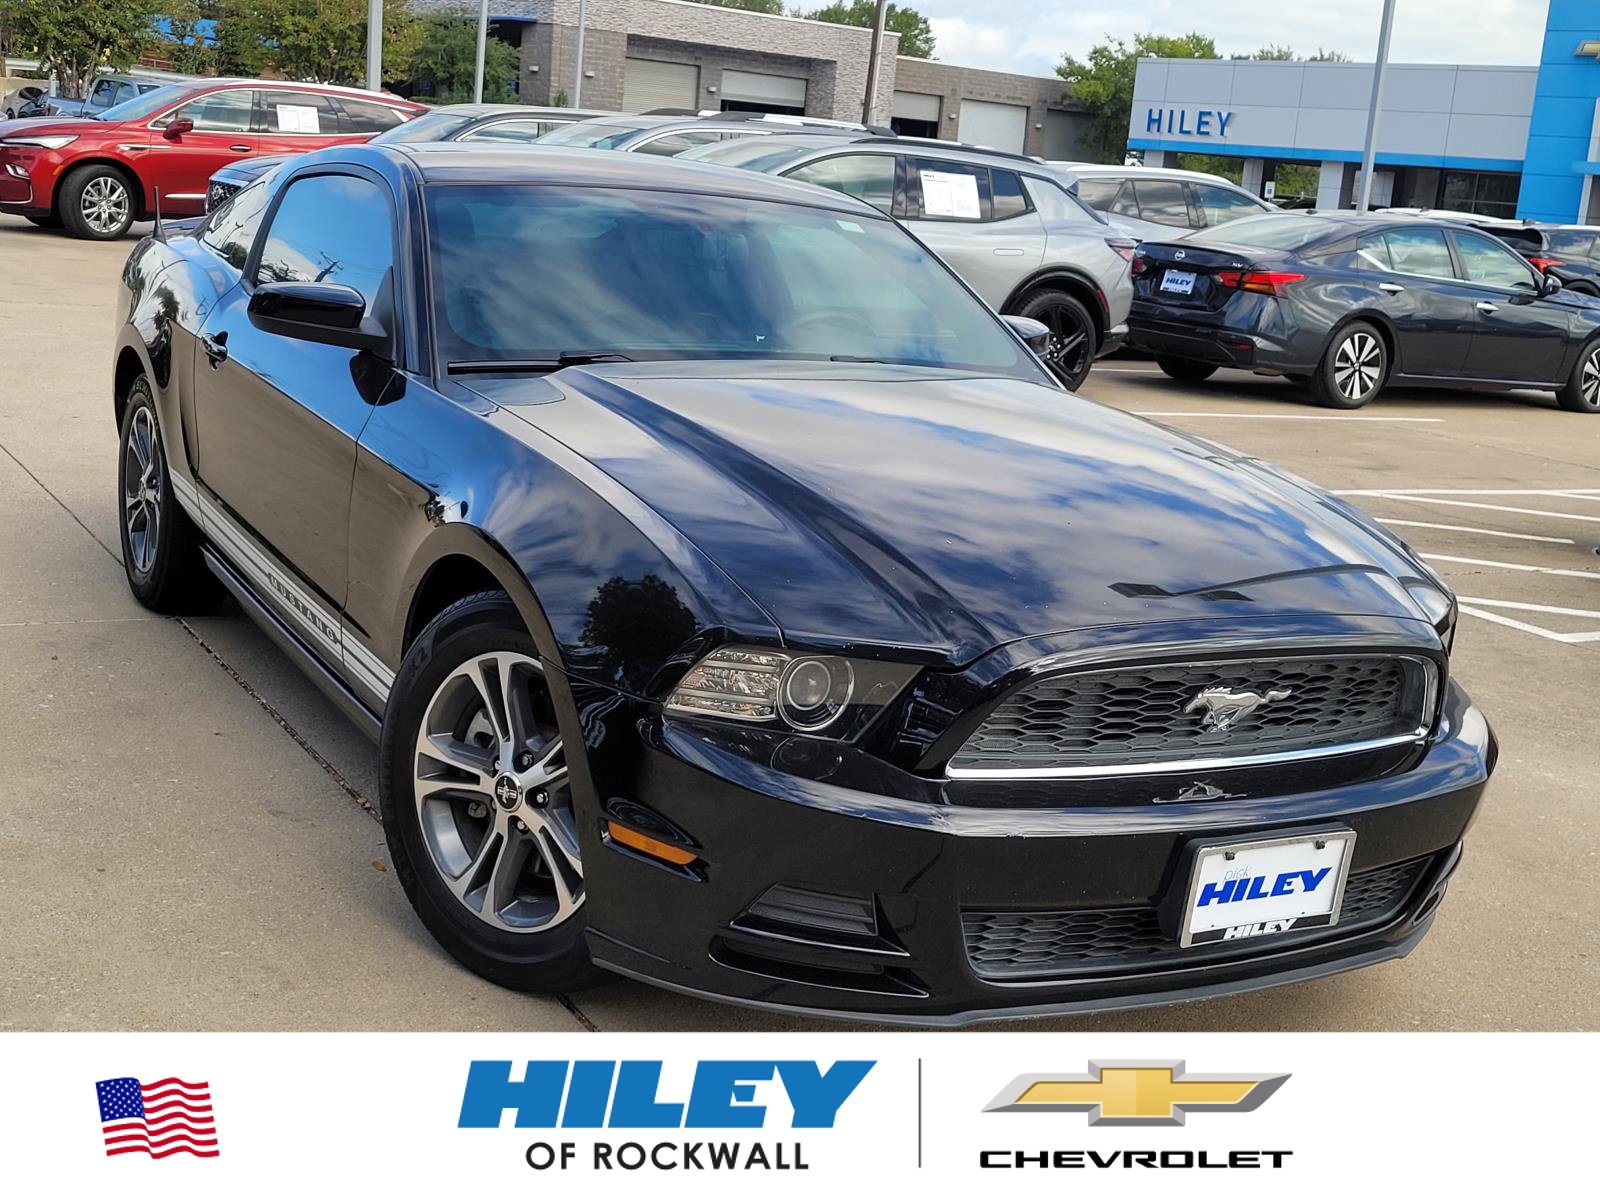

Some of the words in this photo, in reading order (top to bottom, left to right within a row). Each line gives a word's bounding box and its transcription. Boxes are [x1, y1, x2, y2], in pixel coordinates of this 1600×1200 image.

[1146, 108, 1232, 136] HILEY
[1166, 277, 1192, 286] HILEY
[1197, 867, 1333, 907] HILEY
[1223, 918, 1298, 940] HILEY
